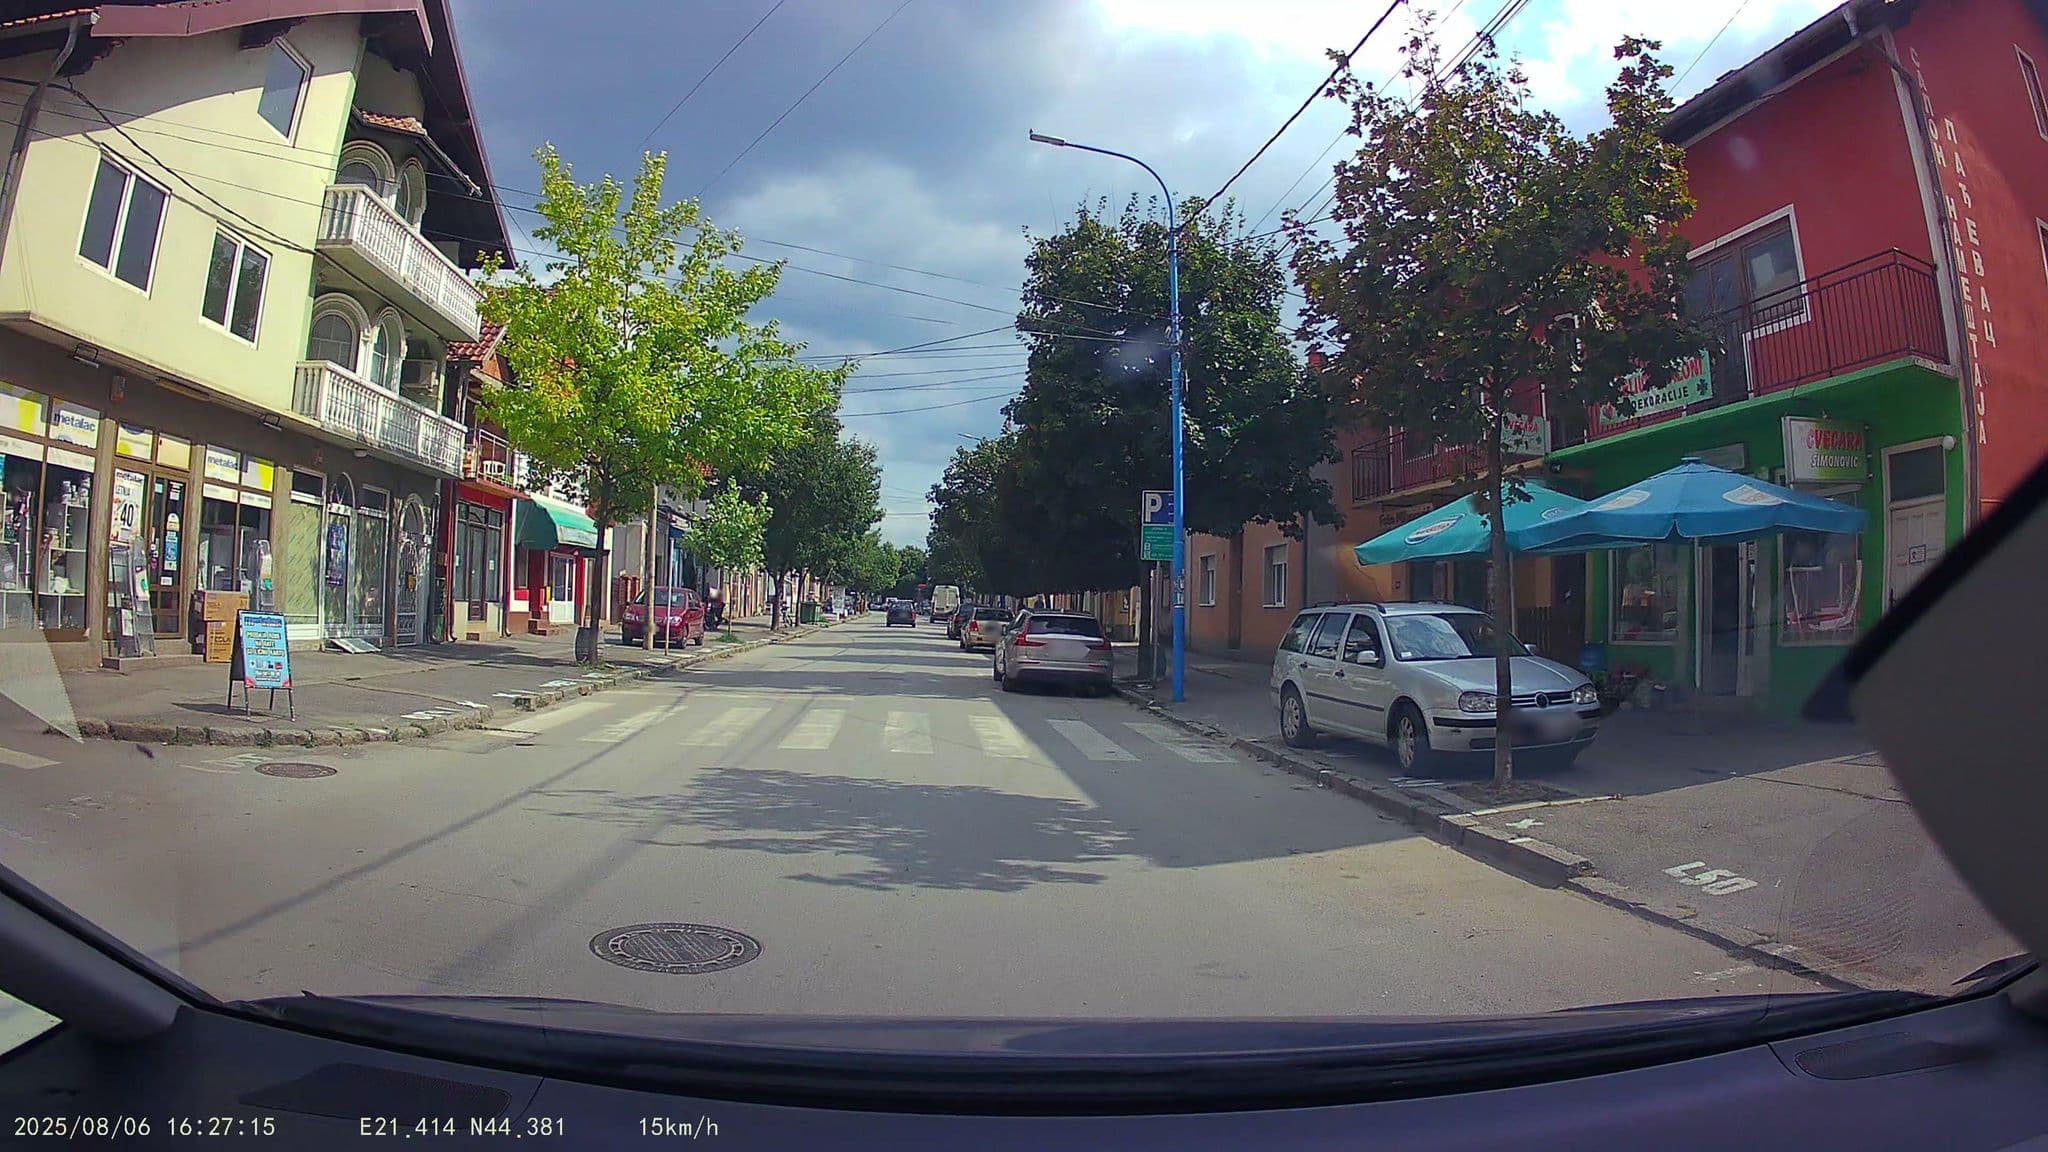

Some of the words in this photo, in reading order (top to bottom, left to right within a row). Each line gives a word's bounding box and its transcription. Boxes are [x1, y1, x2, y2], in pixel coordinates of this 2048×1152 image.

[1945, 195, 1987, 445] НАМЕШТАЈА
[54, 412, 96, 432] metalac
[1145, 493, 1162, 522] P
